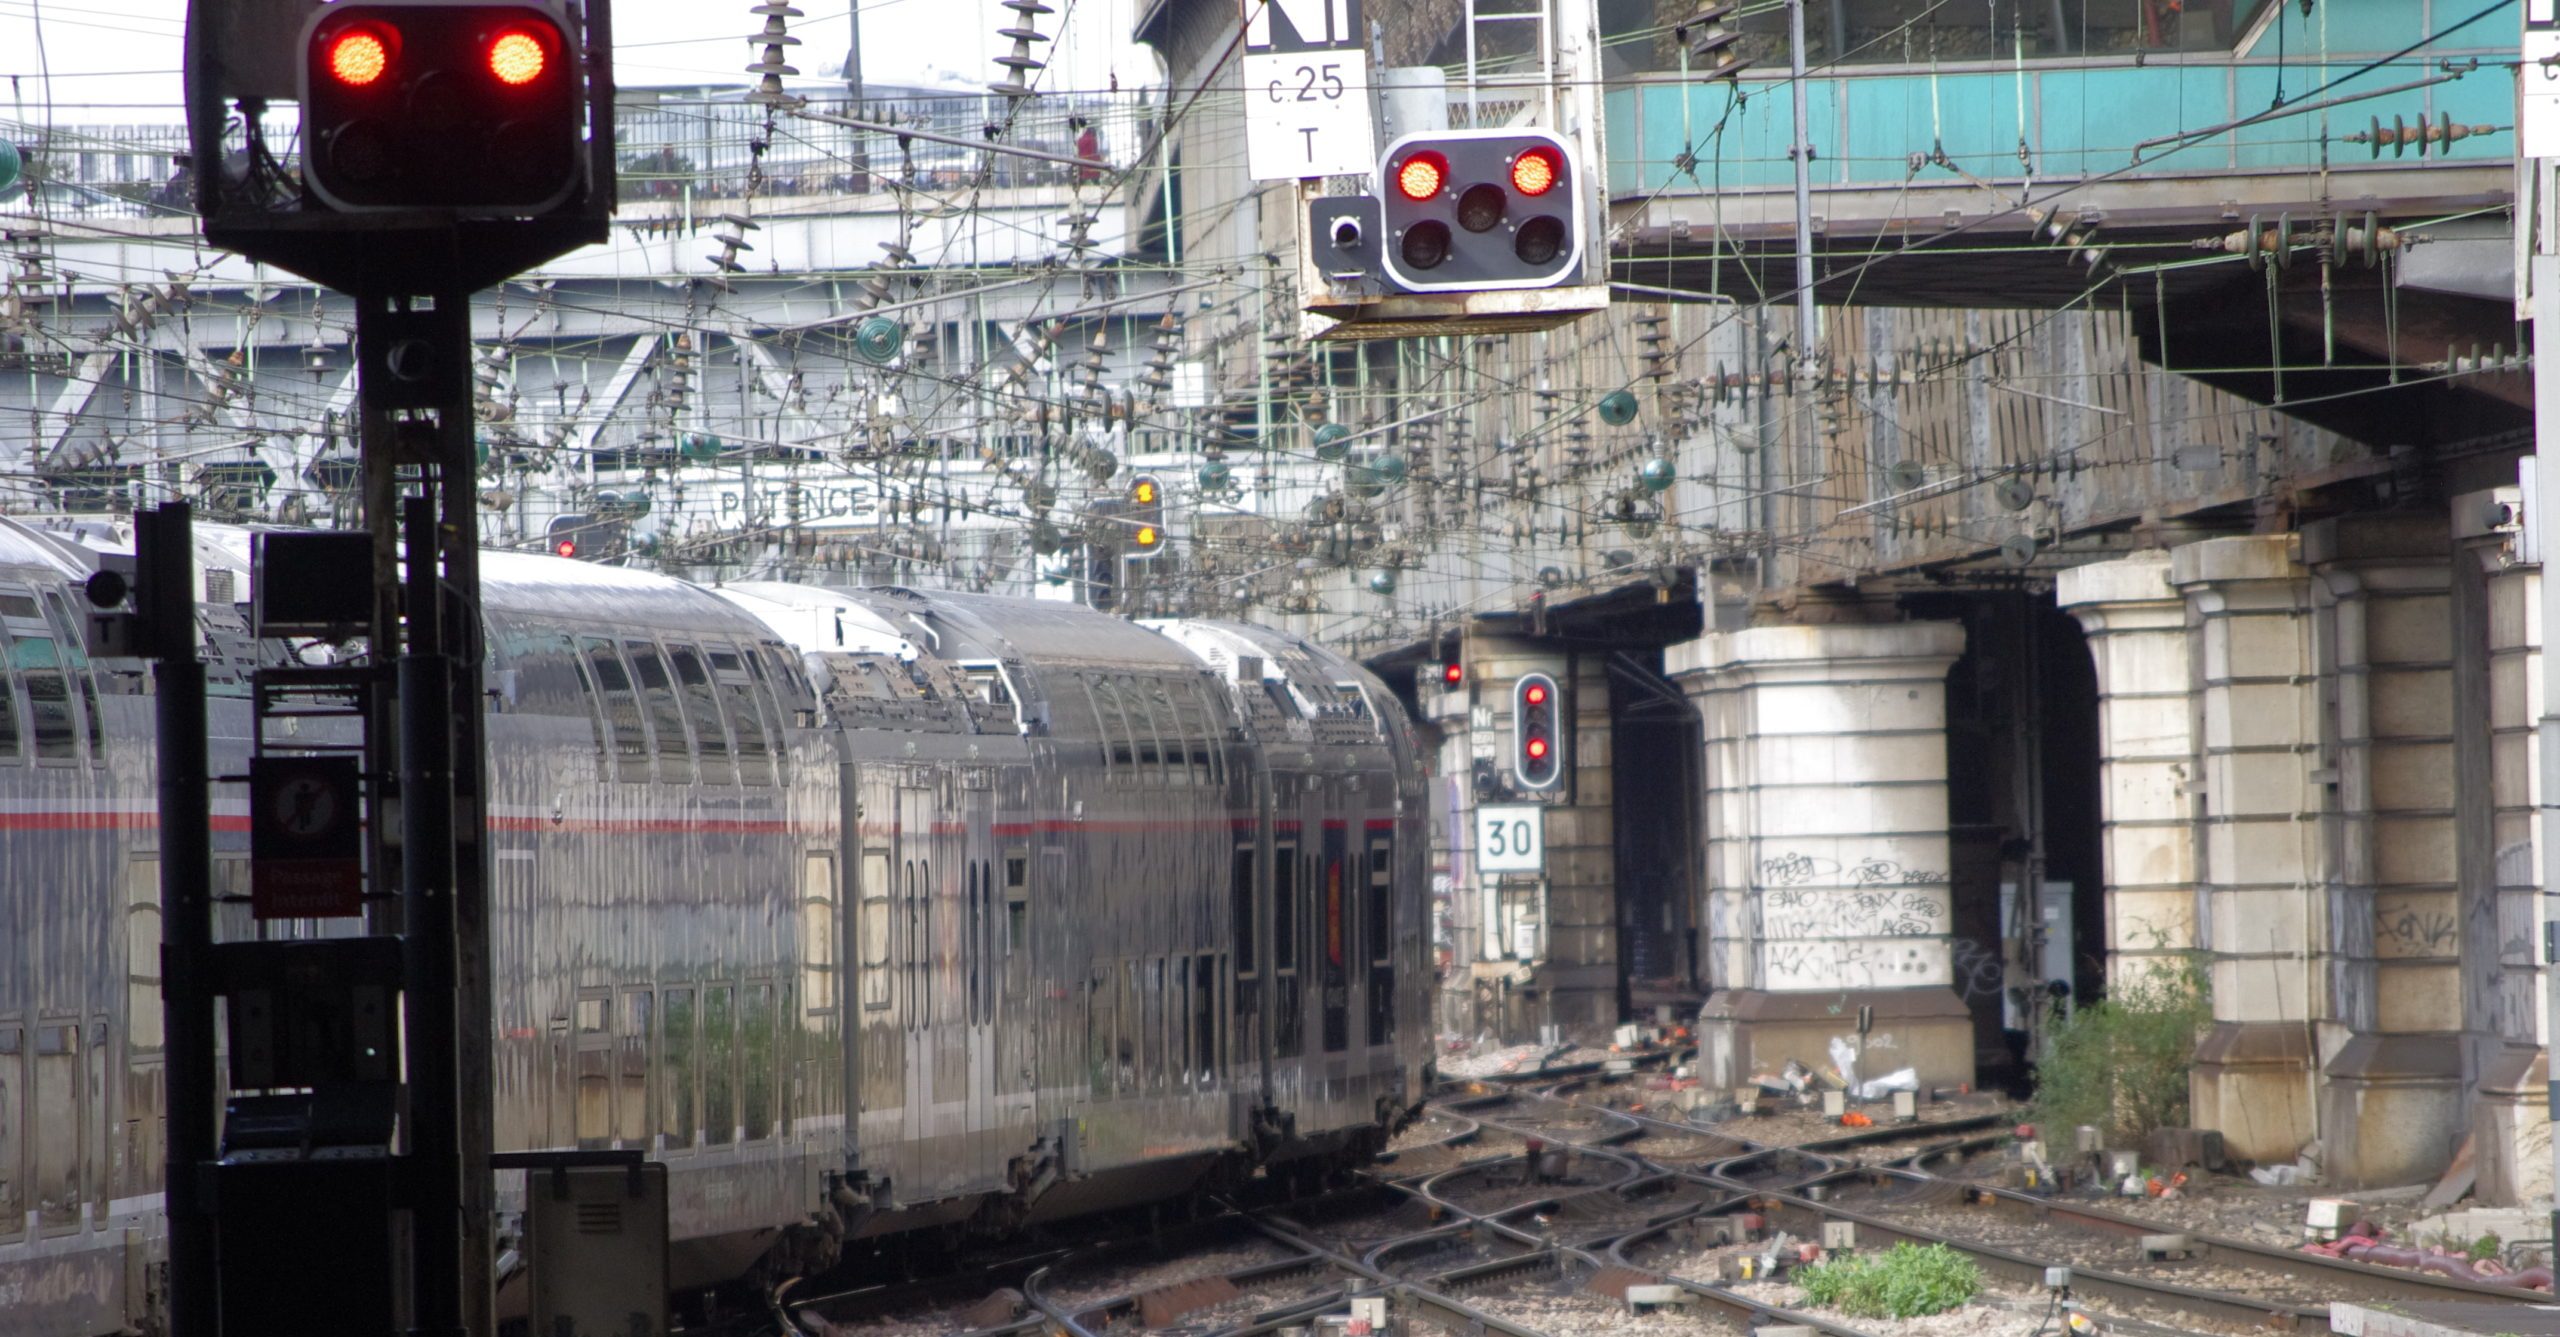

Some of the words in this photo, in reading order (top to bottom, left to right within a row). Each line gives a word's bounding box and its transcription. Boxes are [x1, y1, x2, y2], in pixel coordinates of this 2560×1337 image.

[1298, 127, 1319, 162] T
[722, 486, 868, 520] POTNCE
[94, 617, 116, 643] T
[1487, 820, 1531, 856] 30
